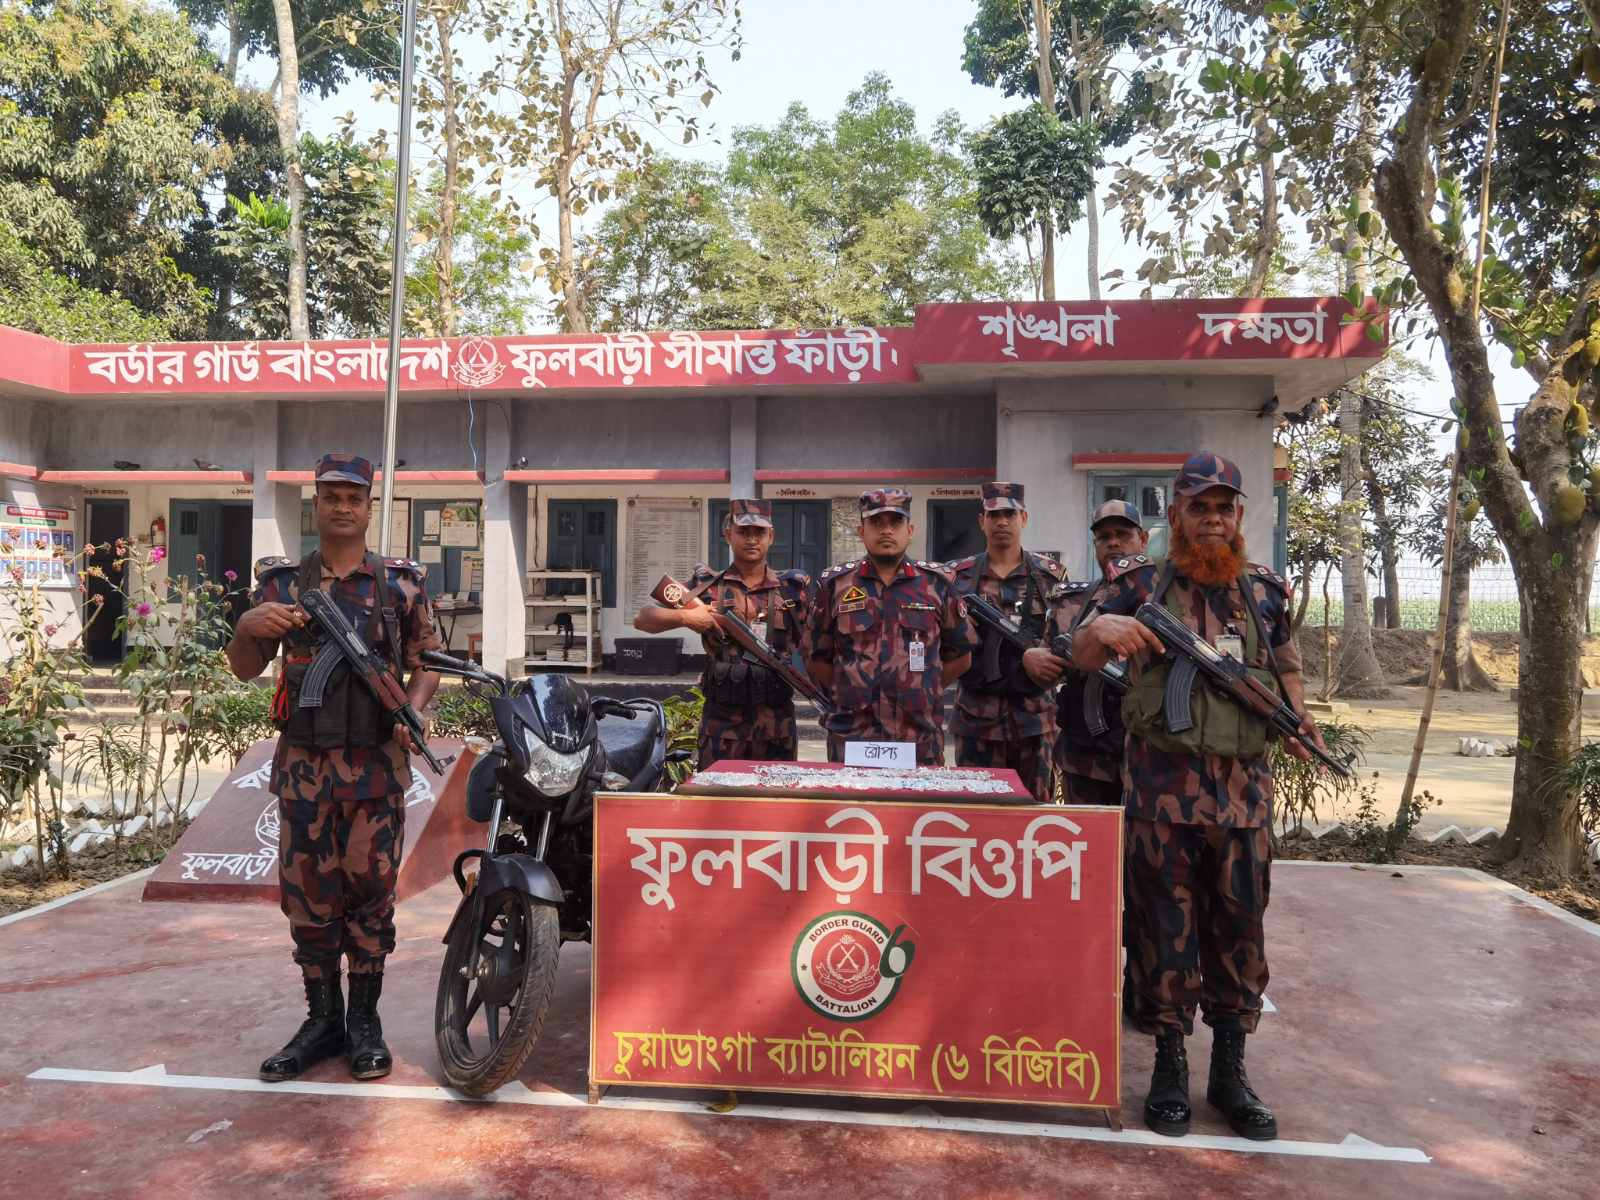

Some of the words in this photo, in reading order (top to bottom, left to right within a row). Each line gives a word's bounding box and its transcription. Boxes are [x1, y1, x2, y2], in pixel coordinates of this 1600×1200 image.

[978, 305, 1121, 358] শৃঙ্খলা
[1197, 303, 1328, 344] দক্ষতা
[84, 344, 187, 385] বর্ডার
[193, 342, 261, 383] গার্ড
[506, 331, 656, 389] ফুলবাড়ী
[660, 330, 777, 376] সীমান্ত
[181, 847, 279, 880] ফুলবাড়ী
[626, 807, 889, 911] ফুলবাড়ী
[905, 811, 1088, 900] বিওপি
[808, 918, 849, 942] BORDER
[851, 919, 885, 945] GUARD
[814, 994, 878, 1014] BATTALION
[612, 1028, 757, 1079] চুয়াডাংগা
[764, 1027, 921, 1081] ব্যাটালিয়ন
[931, 1043, 970, 1093] (৬
[981, 1035, 1101, 1101] বিজিবি)
